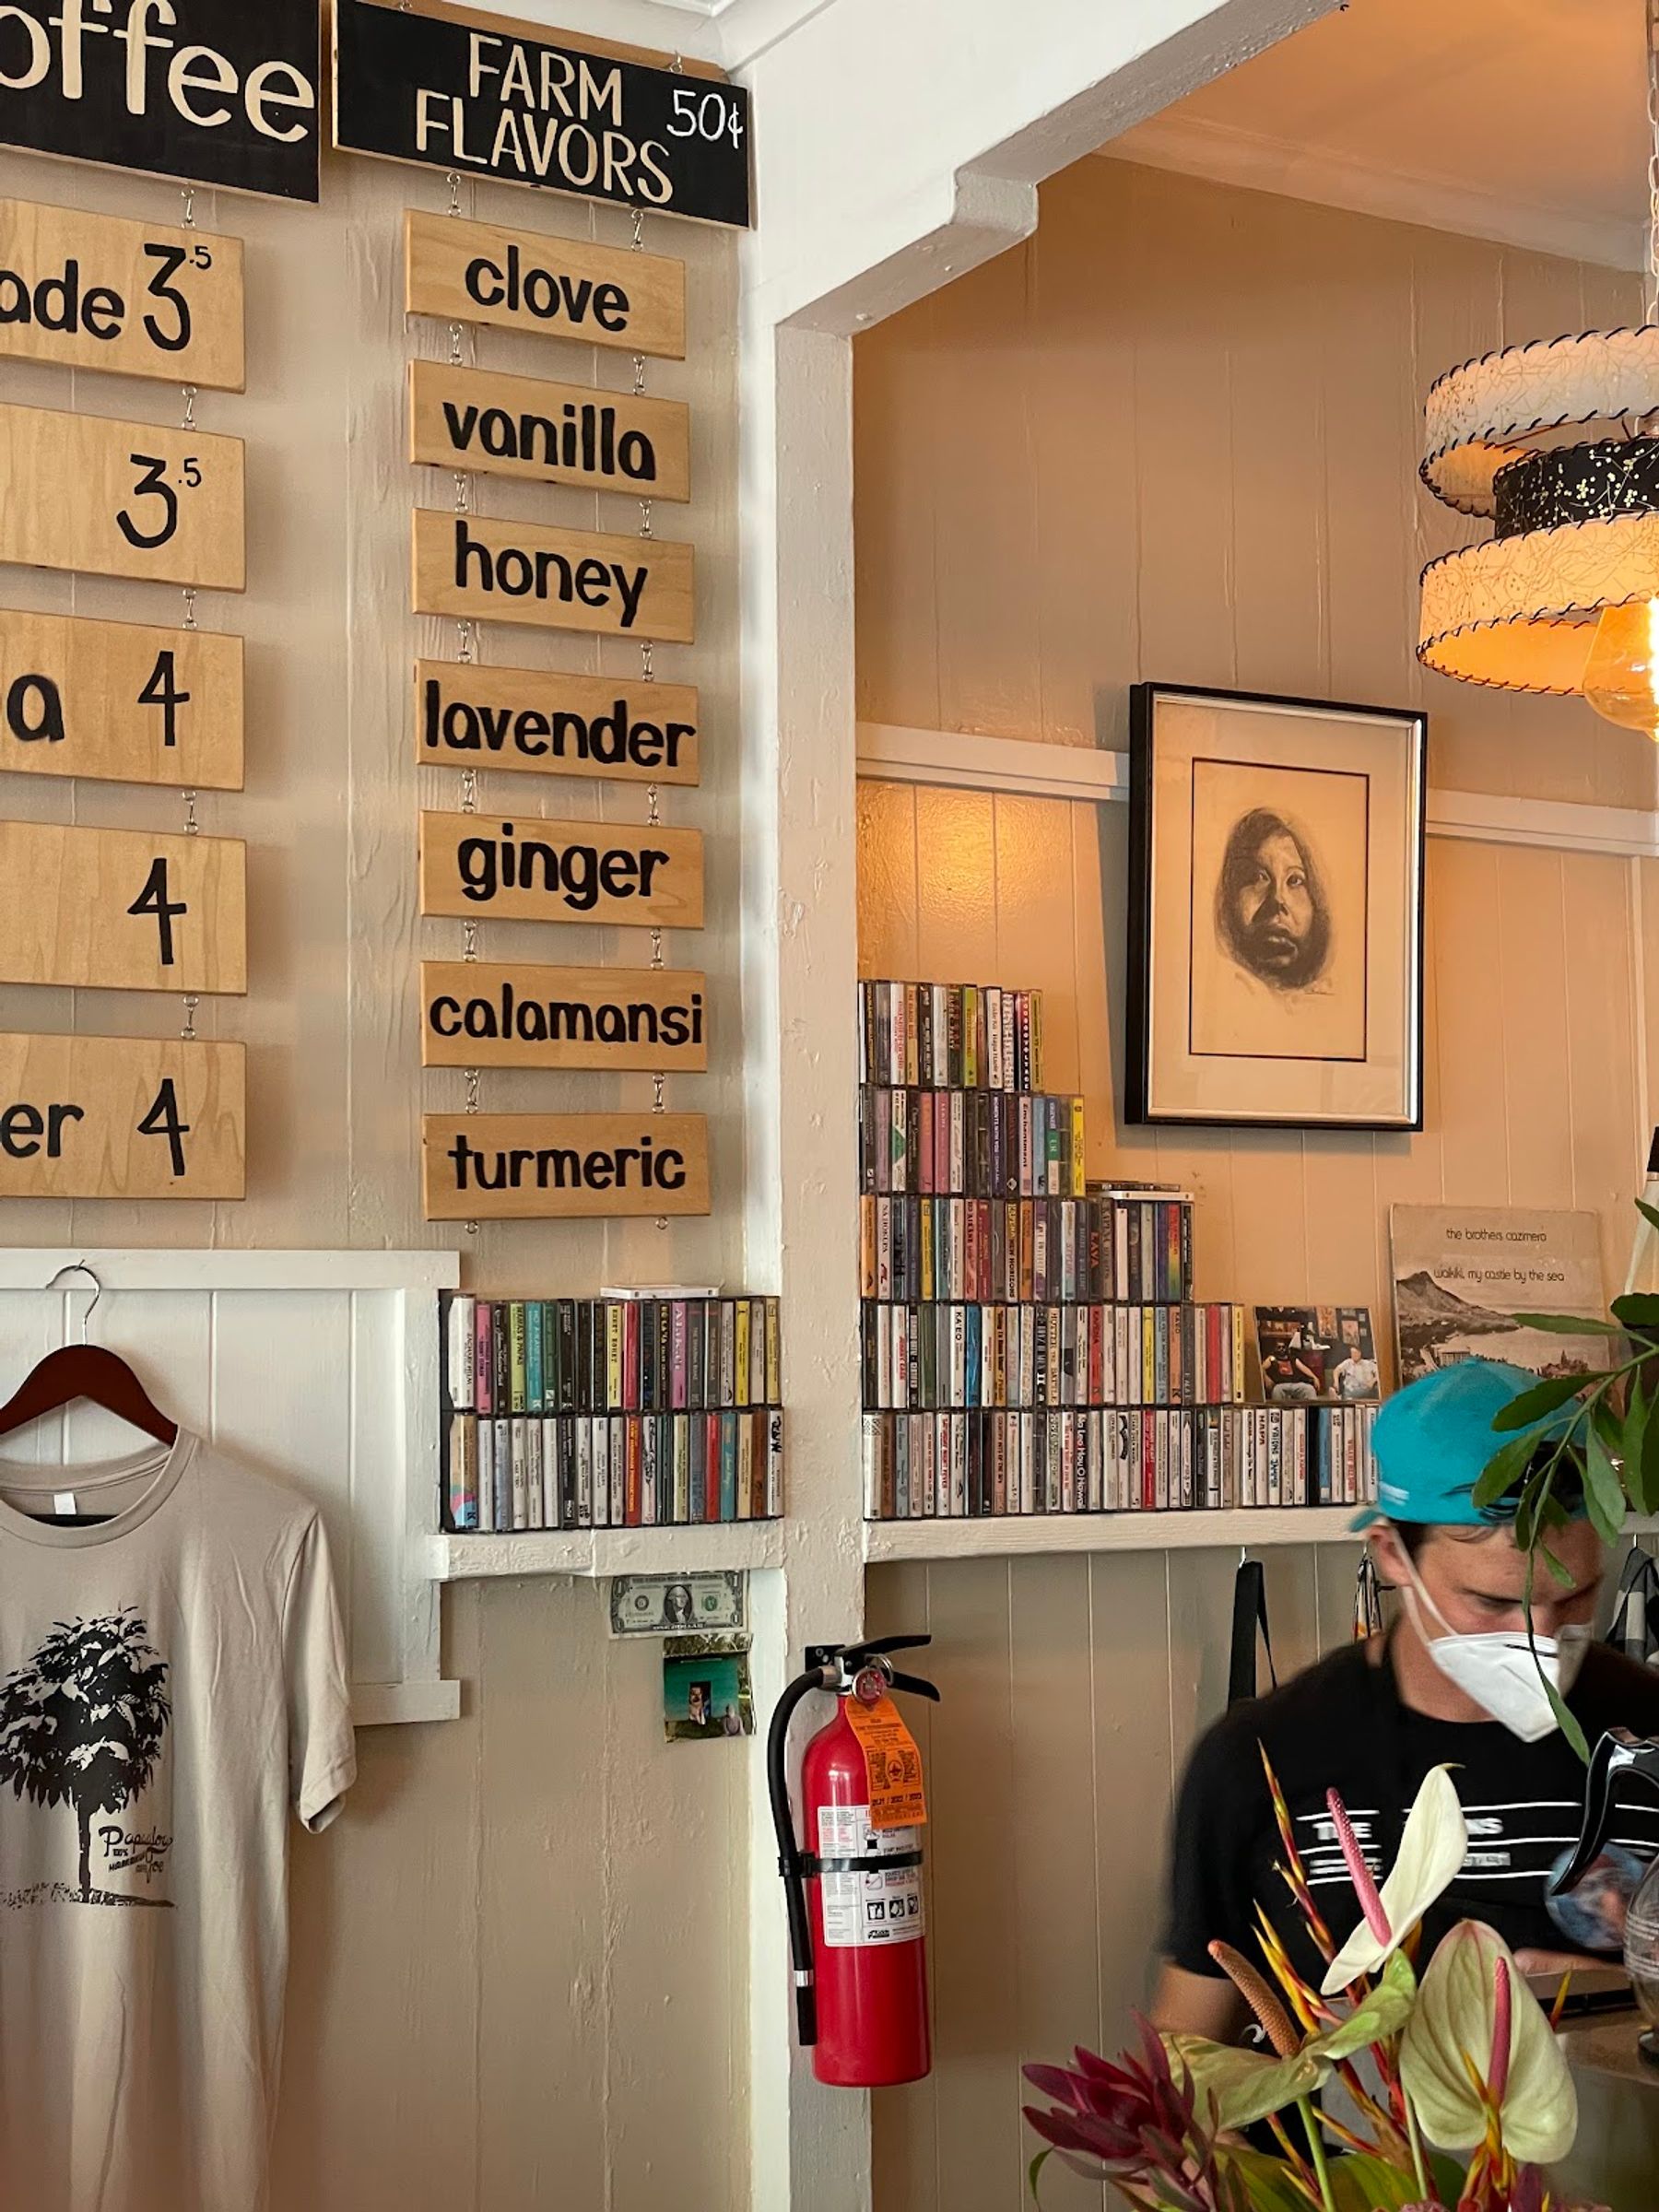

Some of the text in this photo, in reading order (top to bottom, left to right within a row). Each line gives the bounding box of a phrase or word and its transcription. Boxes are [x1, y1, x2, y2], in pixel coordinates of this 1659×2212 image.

[467, 32, 623, 126] FARM
[666, 88, 744, 150] 50¢
[415, 88, 676, 206] FLAVORS
[0, 259, 125, 340] ade
[465, 244, 630, 332] clove
[441, 402, 656, 485] vanilla
[455, 520, 649, 628] honey
[6, 650, 191, 747] a 4
[425, 679, 697, 768] lavender
[457, 822, 670, 911] ginger
[127, 857, 187, 966] 4
[429, 982, 702, 1046] calamansi
[0, 1078, 190, 1176] er 4
[447, 1135, 687, 1191] turmeric
[1446, 1228, 1547, 1242] the brothers cazimero
[1467, 1271, 1483, 1283] my
[1485, 1269, 1512, 1280] castle
[1513, 1269, 1527, 1283] by
[1528, 1269, 1545, 1281] the
[1547, 1272, 1565, 1282] sea
[1077, 1414, 1086, 1428] Na
[1077, 1430, 1086, 1446] Leo
[1077, 1448, 1086, 1465] Hou
